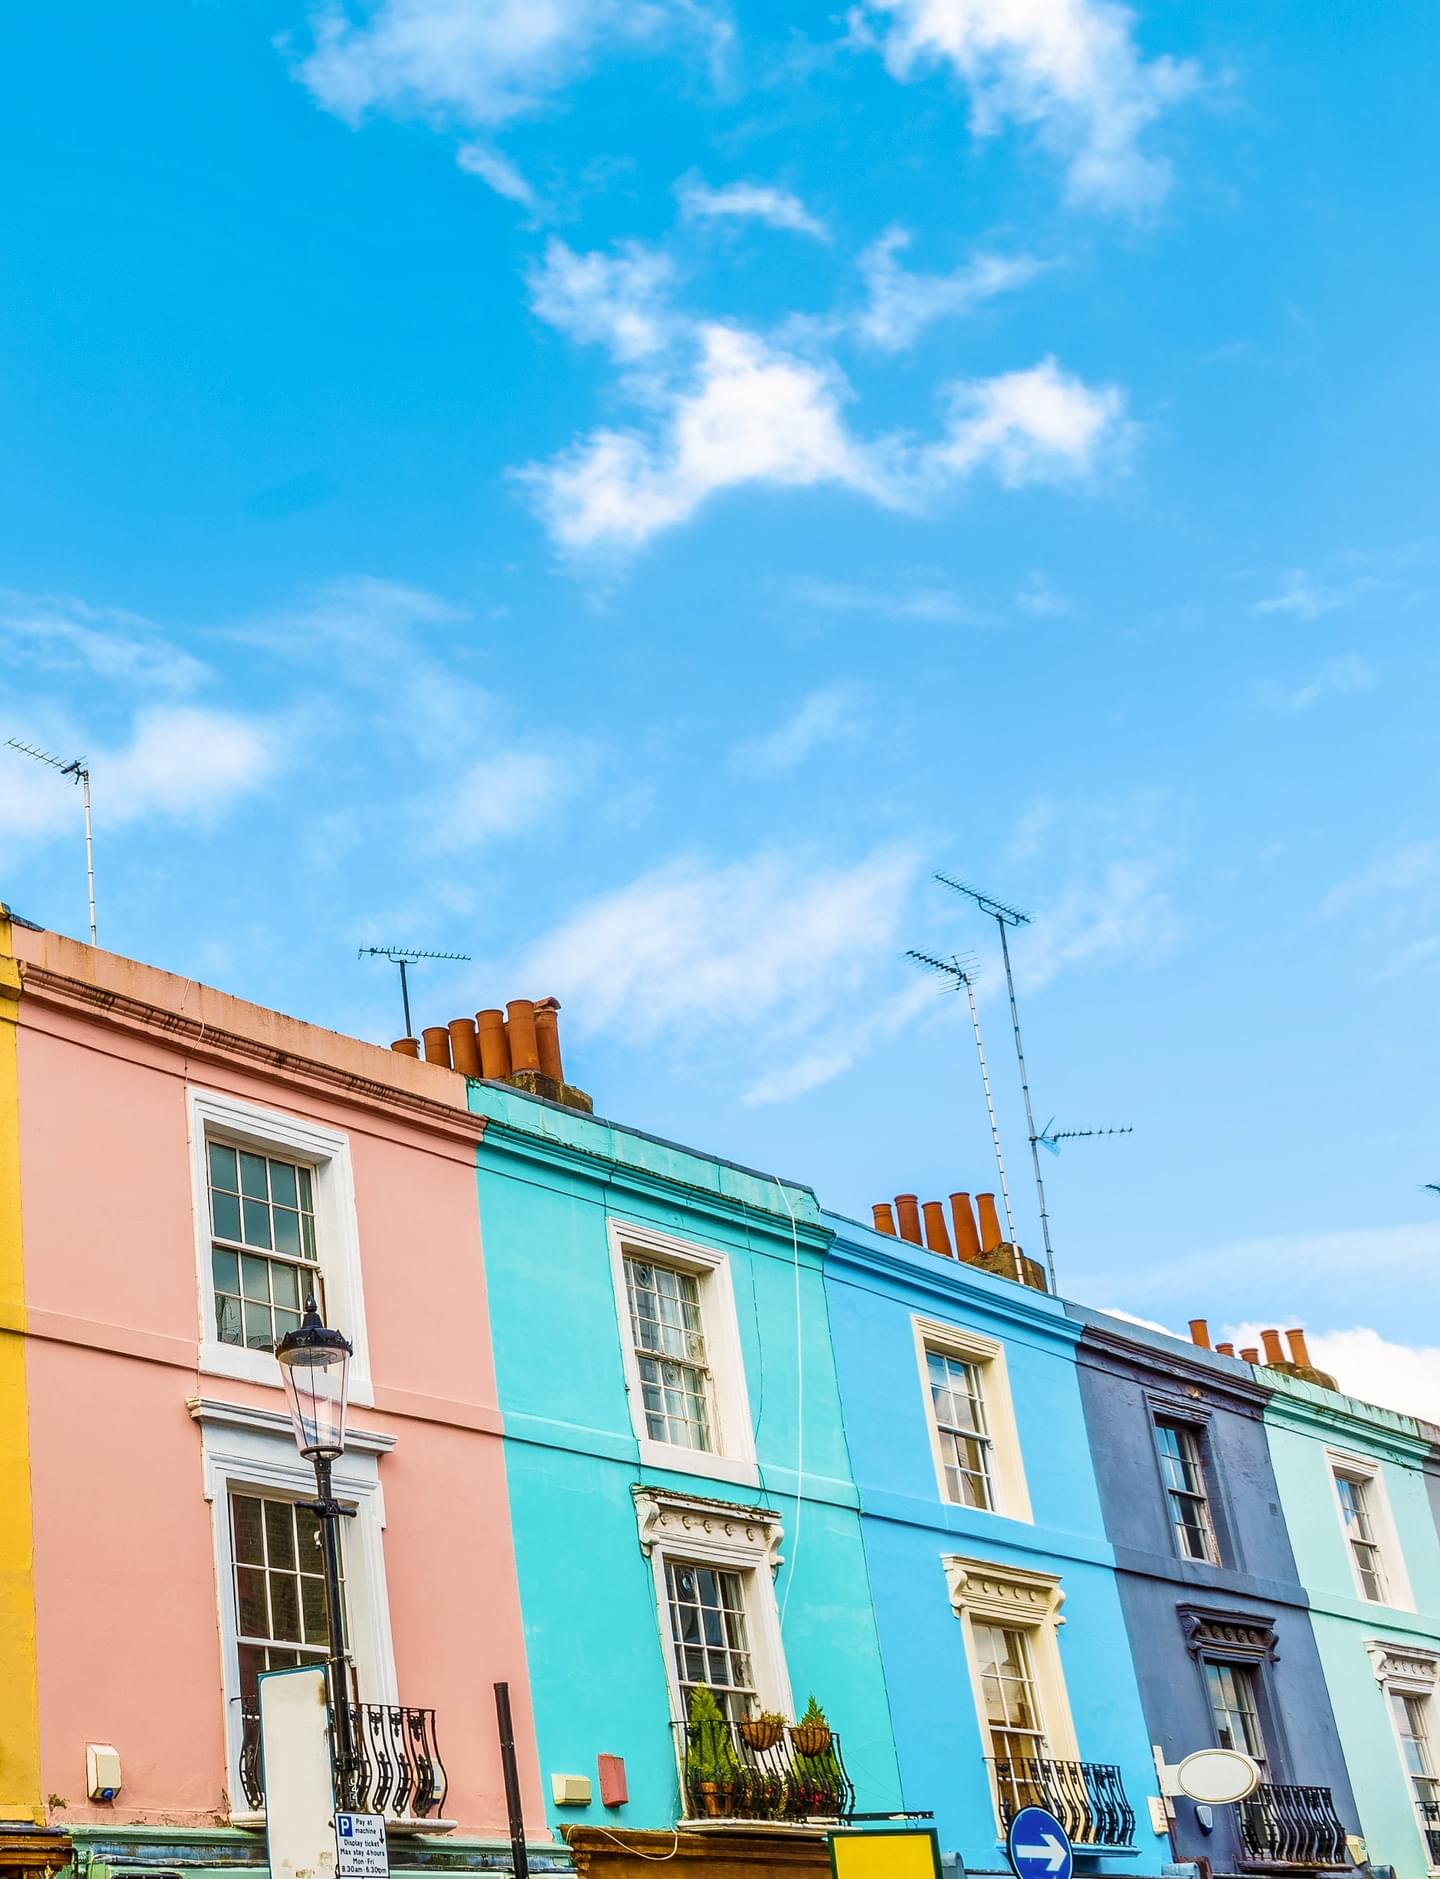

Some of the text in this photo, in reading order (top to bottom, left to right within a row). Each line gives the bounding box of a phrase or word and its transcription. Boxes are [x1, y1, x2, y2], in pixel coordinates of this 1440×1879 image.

[340, 1818, 350, 1834] P
[356, 1818, 365, 1826] Pay
[344, 1839, 363, 1848] Display
